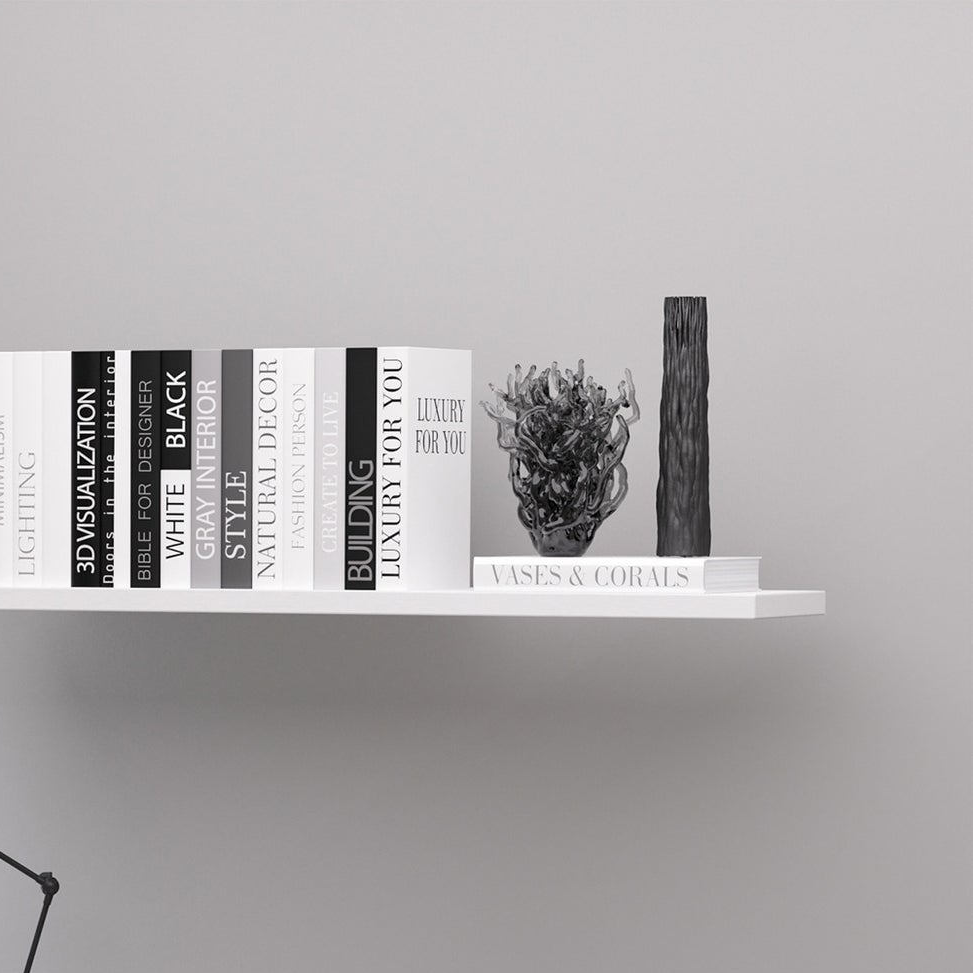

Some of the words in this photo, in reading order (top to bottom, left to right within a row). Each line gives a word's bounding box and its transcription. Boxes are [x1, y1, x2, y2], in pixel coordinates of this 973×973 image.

[103, 356, 115, 439] interior
[166, 371, 186, 448] BLACK
[258, 359, 277, 450] DECOR
[292, 383, 306, 456] PERSON
[323, 391, 339, 436] LIVE
[383, 358, 403, 408] YOU
[417, 397, 465, 423] LUXURY
[138, 379, 152, 472] DESIGNER
[196, 380, 216, 489] INTERIOR
[323, 443, 338, 470] TO
[382, 417, 402, 467] FOR
[415, 429, 439, 454] FOR
[442, 430, 467, 455] YOU
[77, 388, 96, 540] VISUALIZATION
[103, 454, 115, 484] the
[18, 452, 36, 576] LIGHTING
[103, 498, 115, 515] in
[138, 482, 152, 520] FOR
[166, 483, 184, 560] WHITE
[195, 496, 215, 560] GRAY
[225, 471, 247, 559] STYLE
[257, 458, 277, 579] NATURAL
[291, 463, 305, 549] FASHION
[322, 475, 338, 553] CREATE
[348, 459, 374, 582] BUILDING
[381, 477, 401, 579] LUXURY
[77, 543, 95, 574] 3D
[102, 531, 115, 584] Doors
[138, 531, 152, 581] BIBLE
[491, 564, 562, 585] VASES
[569, 565, 585, 586] &
[594, 566, 689, 588] CORALS
